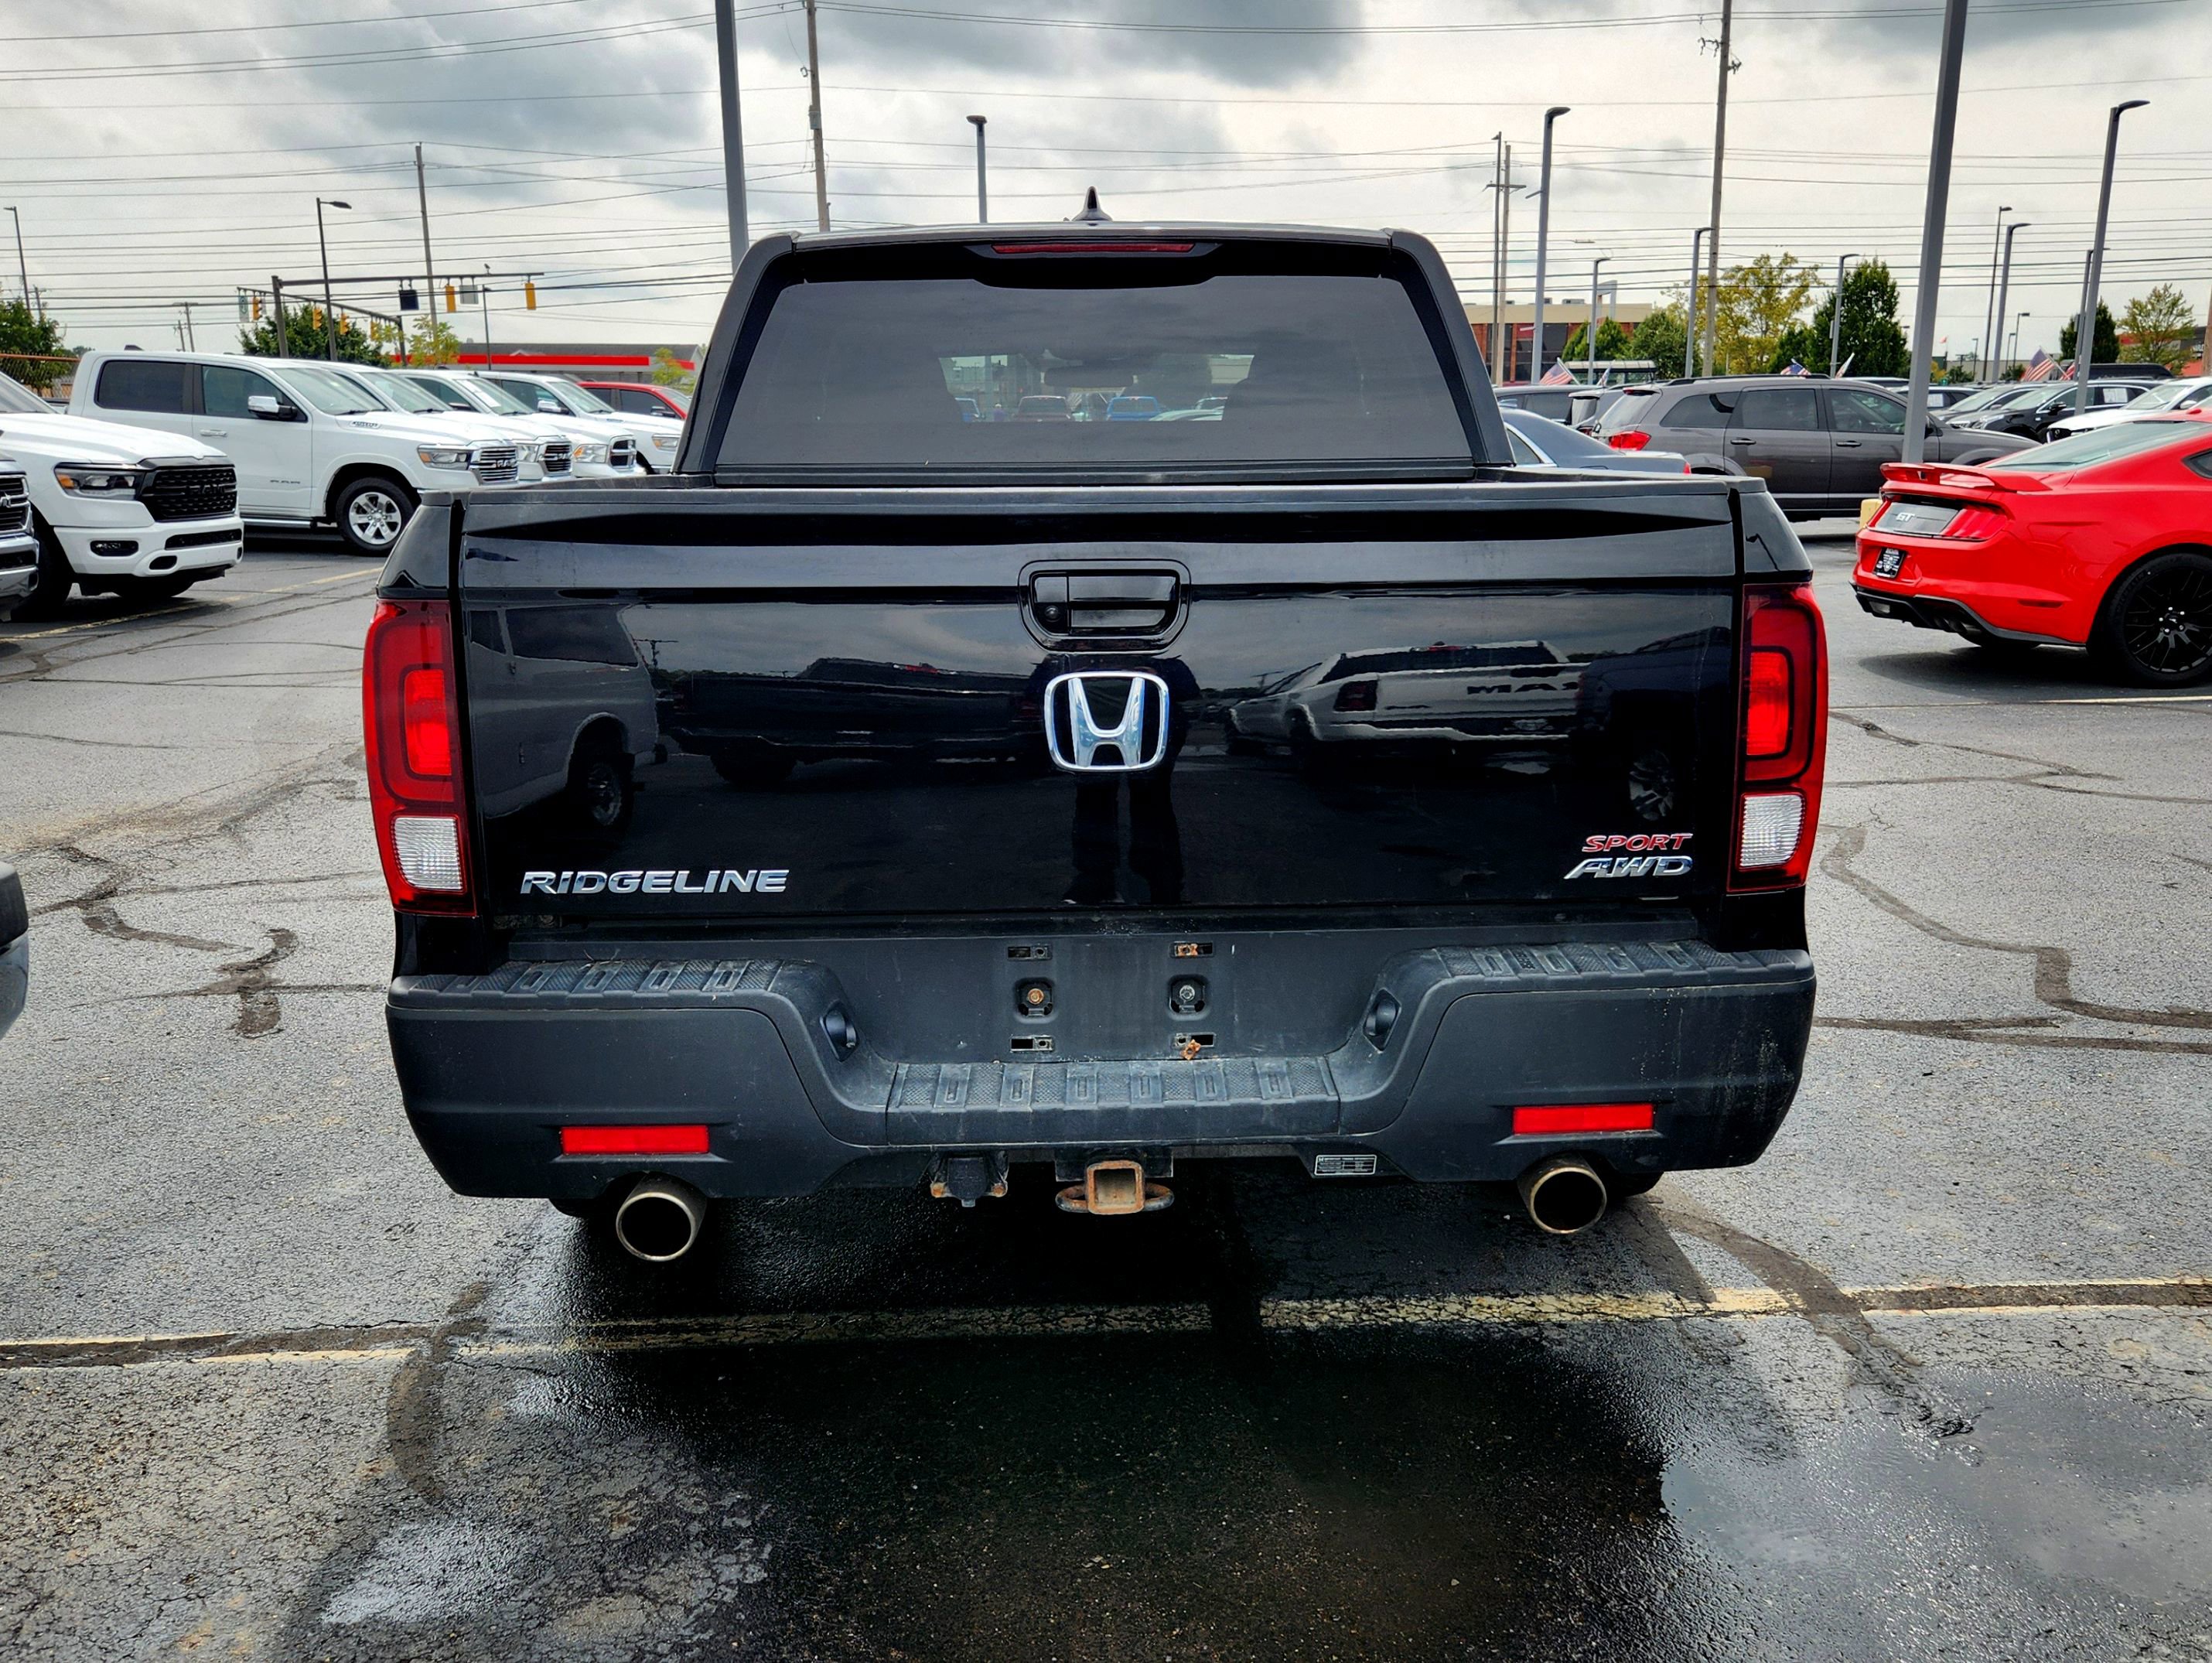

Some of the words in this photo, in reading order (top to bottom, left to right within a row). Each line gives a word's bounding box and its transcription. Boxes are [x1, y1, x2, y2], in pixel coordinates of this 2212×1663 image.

[1896, 512, 1916, 522] GT
[1582, 833, 1693, 852] SPORT
[1564, 855, 1693, 879] AWD
[520, 869, 790, 894] RIDGELINE
